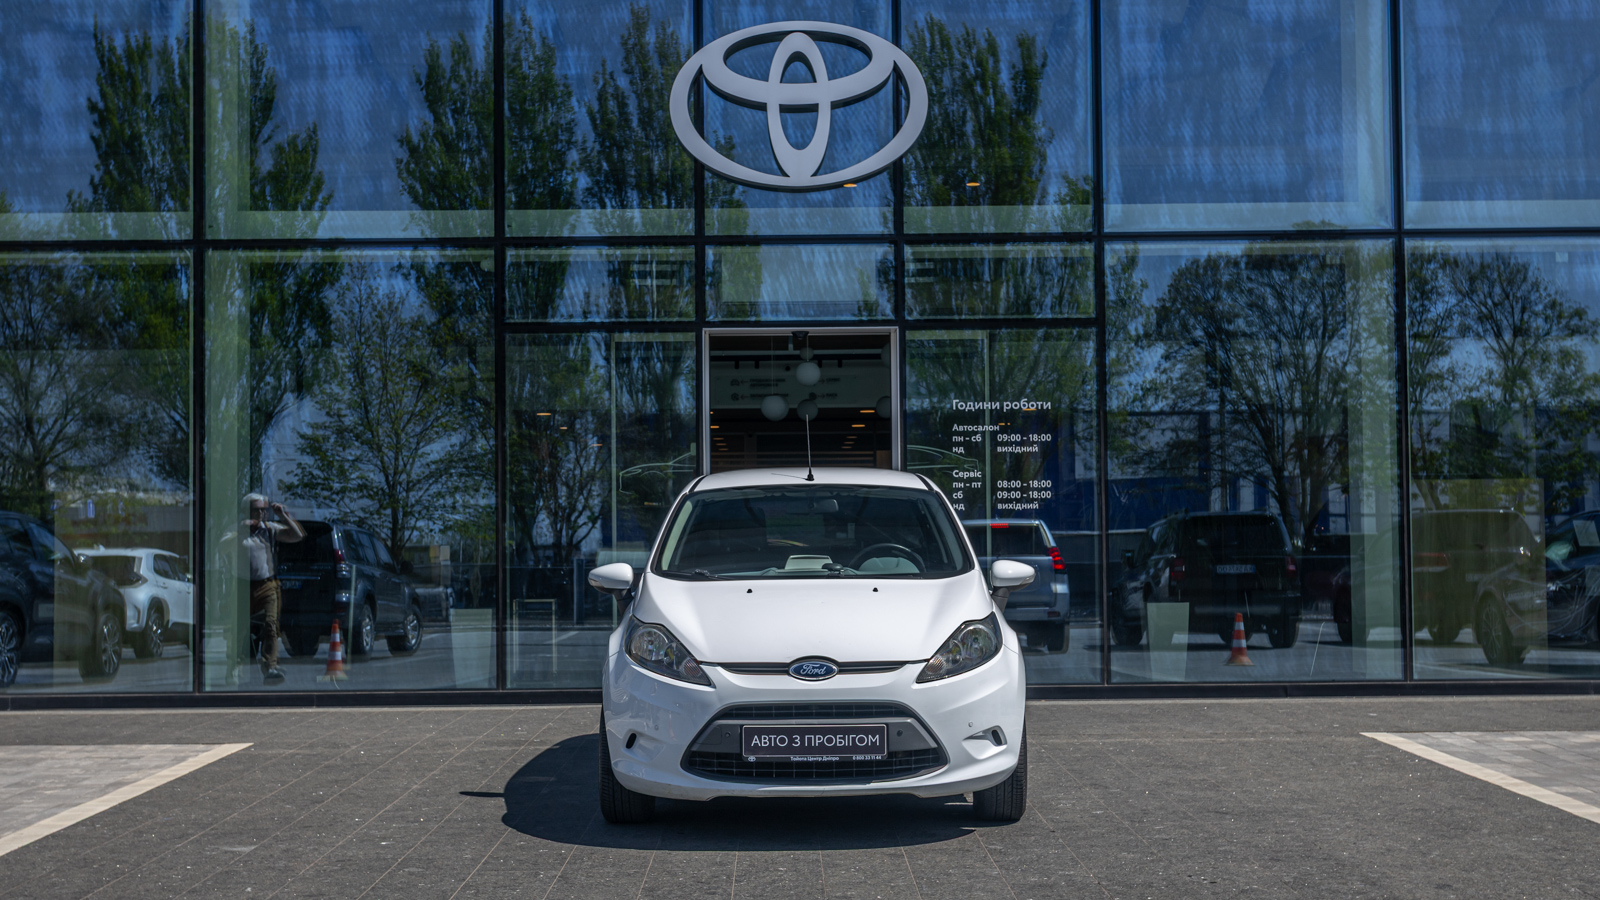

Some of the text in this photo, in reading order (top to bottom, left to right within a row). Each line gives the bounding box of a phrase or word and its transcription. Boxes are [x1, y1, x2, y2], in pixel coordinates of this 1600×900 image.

[952, 399, 1051, 412] Години роботи
[972, 434, 982, 442] сб
[997, 434, 1021, 442] 09:00
[953, 446, 964, 454] нд
[997, 444, 1038, 453] вихідний
[953, 470, 982, 479] Сервіс
[997, 480, 1021, 488] 08:00
[1029, 480, 1051, 488] 18:00
[998, 501, 1039, 510] вихідний
[800, 664, 827, 675] Ford
[751, 735, 788, 747] АВТО
[805, 734, 880, 747] ПРОБІГОМ
